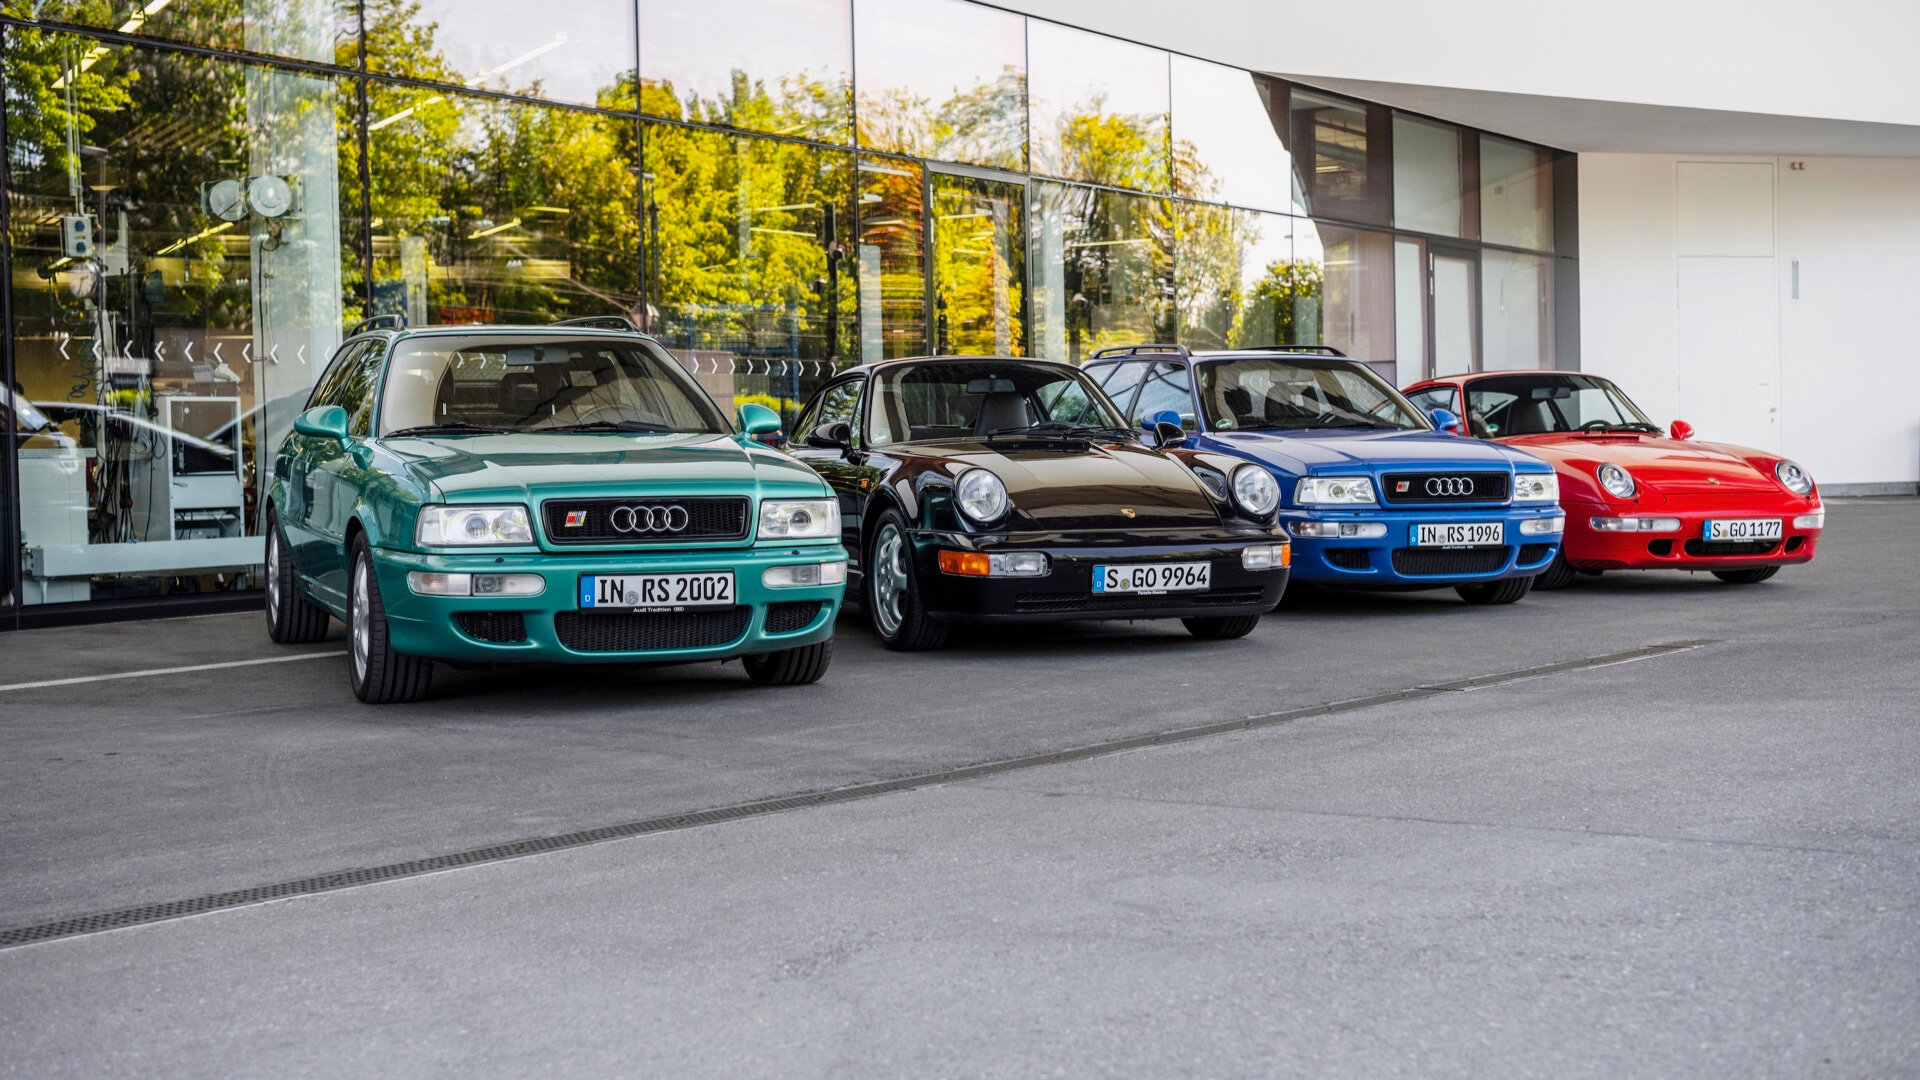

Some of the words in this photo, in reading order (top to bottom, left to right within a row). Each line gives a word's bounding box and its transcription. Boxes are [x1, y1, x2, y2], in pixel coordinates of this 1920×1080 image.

[1420, 526, 1437, 543] IN
[1447, 526, 1465, 543] RS
[1468, 525, 1500, 542] 1996
[1712, 522, 1721, 538] S
[1729, 522, 1747, 537] GO
[1749, 521, 1781, 537] 1177
[1106, 569, 1119, 589] S
[1132, 567, 1157, 588] GO
[1161, 565, 1207, 587] 9964
[597, 578, 624, 604] IN
[642, 578, 670, 603] RS
[675, 576, 729, 602] 2002
